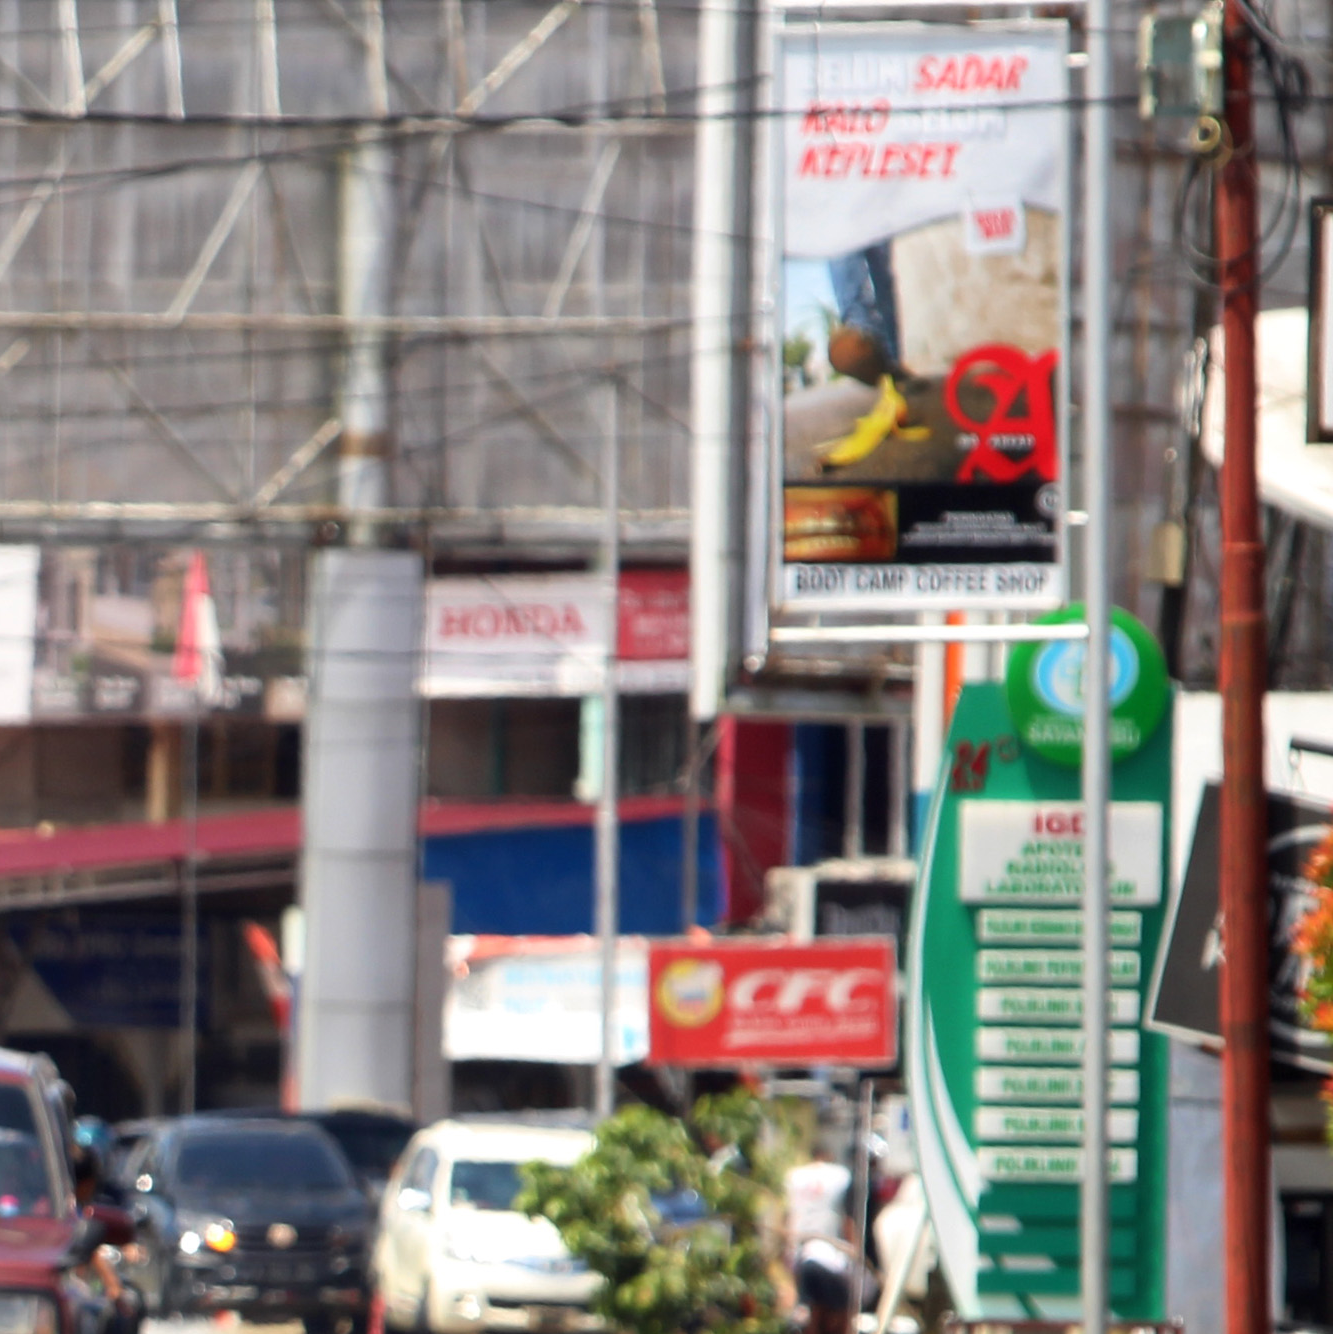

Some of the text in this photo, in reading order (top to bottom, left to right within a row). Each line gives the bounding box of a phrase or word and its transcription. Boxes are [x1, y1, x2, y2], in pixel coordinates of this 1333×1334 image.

[914, 53, 1028, 92] SADAR
[799, 98, 890, 135] KALO
[796, 142, 960, 179] KEPLESET
[796, 569, 1047, 593] BOOT CAMP COFFEE SHOP
[438, 603, 589, 638] HONDA
